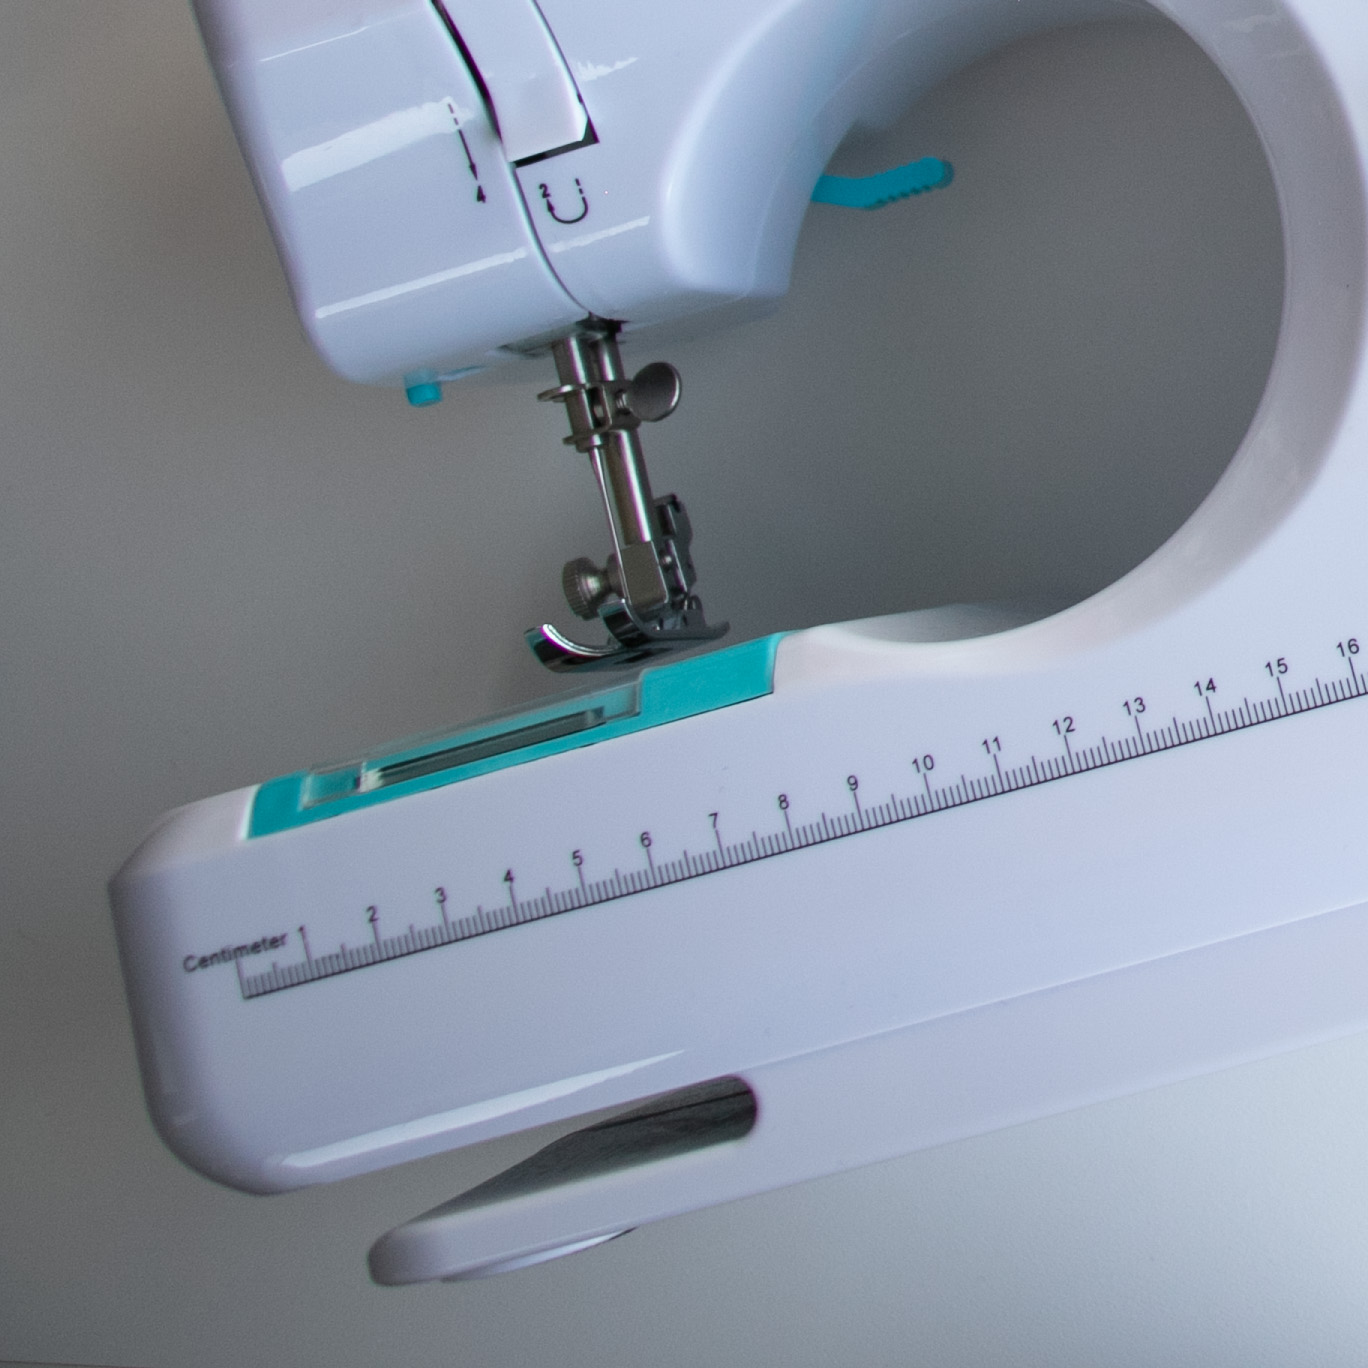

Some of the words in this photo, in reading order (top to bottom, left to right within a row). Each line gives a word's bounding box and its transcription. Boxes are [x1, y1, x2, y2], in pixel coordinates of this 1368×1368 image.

[182, 933, 288, 973] Centimeter
[365, 904, 378, 923] 2
[434, 886, 447, 904] 3
[502, 867, 514, 885] 4
[571, 849, 584, 867] 5
[638, 830, 651, 849] 6
[707, 812, 719, 830] 7
[776, 793, 789, 811] 8
[845, 774, 860, 792] 9
[910, 753, 935, 774] 10
[979, 735, 1003, 755] 11
[1050, 715, 1075, 735] 12
[1121, 696, 1146, 716] 13
[1191, 676, 1217, 697] 14
[1263, 657, 1288, 677] 15
[1335, 638, 1360, 658] 16
